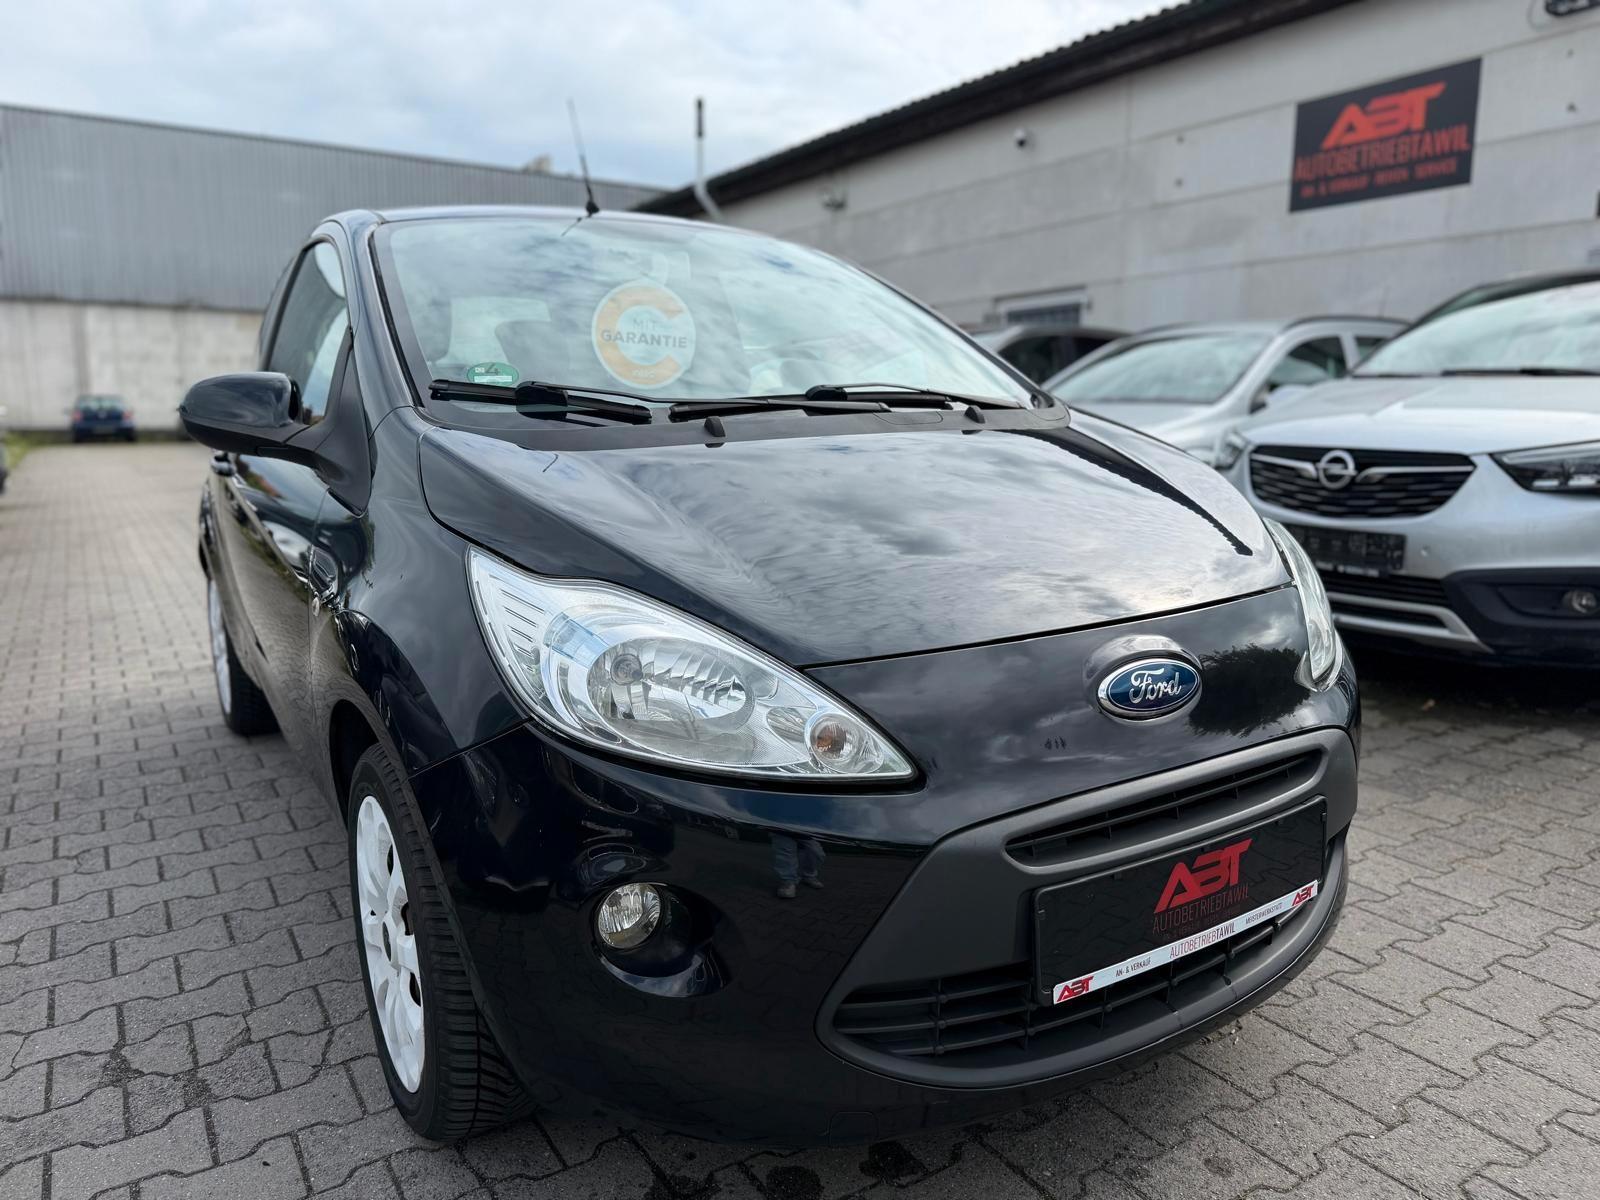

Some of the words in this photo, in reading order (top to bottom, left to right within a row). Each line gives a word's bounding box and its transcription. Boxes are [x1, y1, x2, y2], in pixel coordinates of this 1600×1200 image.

[600, 329, 688, 349] GARANTIE
[1128, 667, 1182, 704] Ford
[1154, 838, 1253, 914] ABT
[1152, 882, 1249, 936] AUTOBETRIEBTAWIL
[1056, 975, 1094, 1002] ABT
[1130, 958, 1151, 972] VERKAUF
[1169, 922, 1236, 959] AUTOBETRIEBTAWIL
